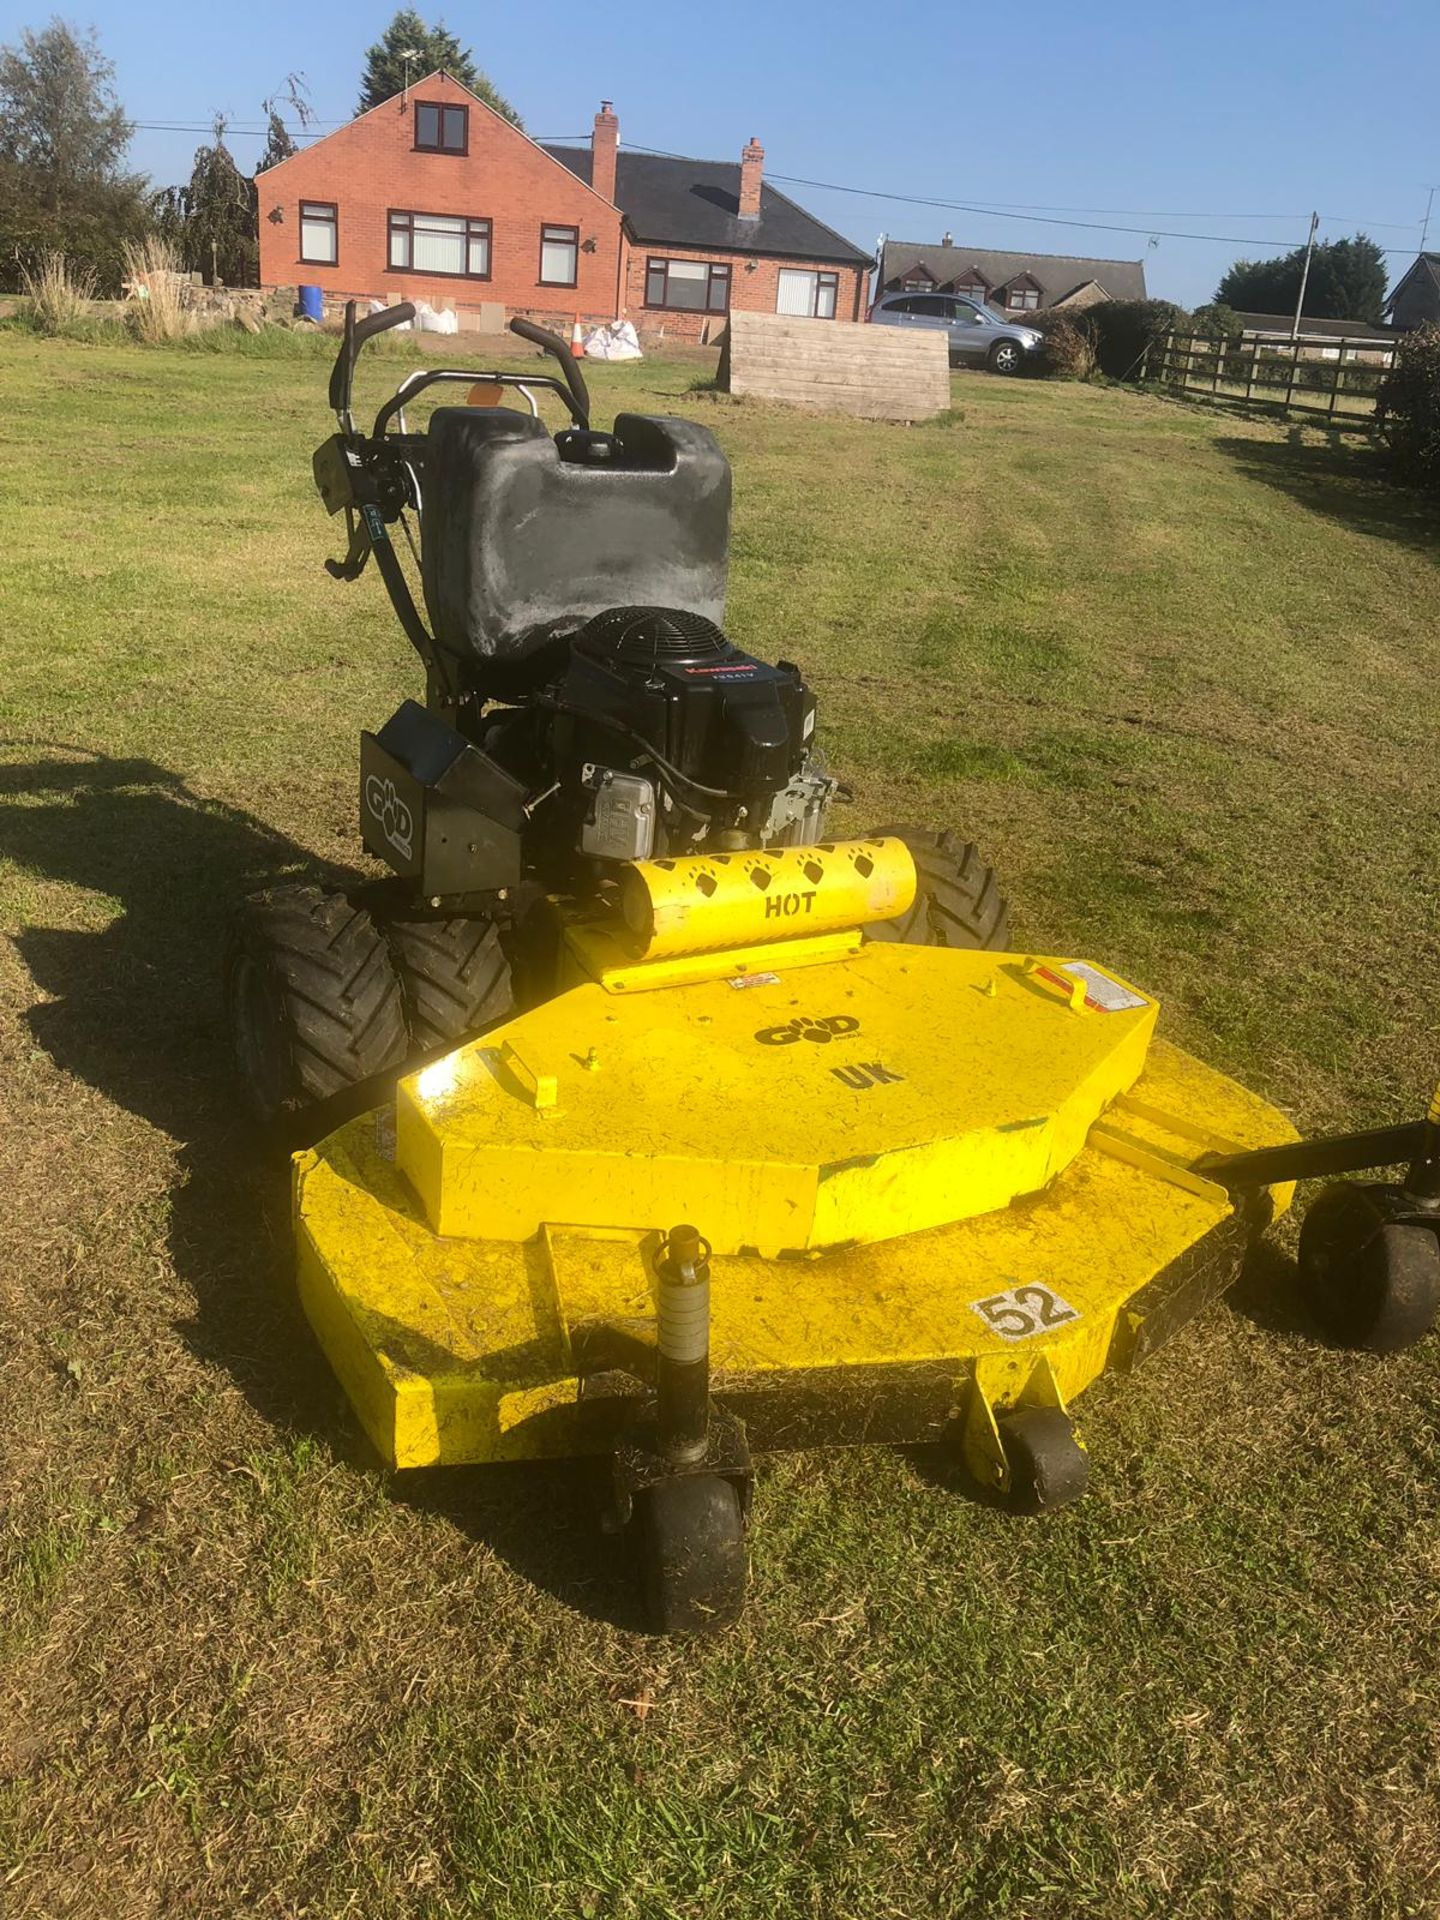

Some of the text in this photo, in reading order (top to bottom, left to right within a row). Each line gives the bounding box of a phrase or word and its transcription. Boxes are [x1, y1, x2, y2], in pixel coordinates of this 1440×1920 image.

[684, 664, 758, 674] Kawasaki
[765, 890, 817, 919] HOT
[829, 1062, 906, 1090] UK
[977, 1286, 1077, 1337] 52
